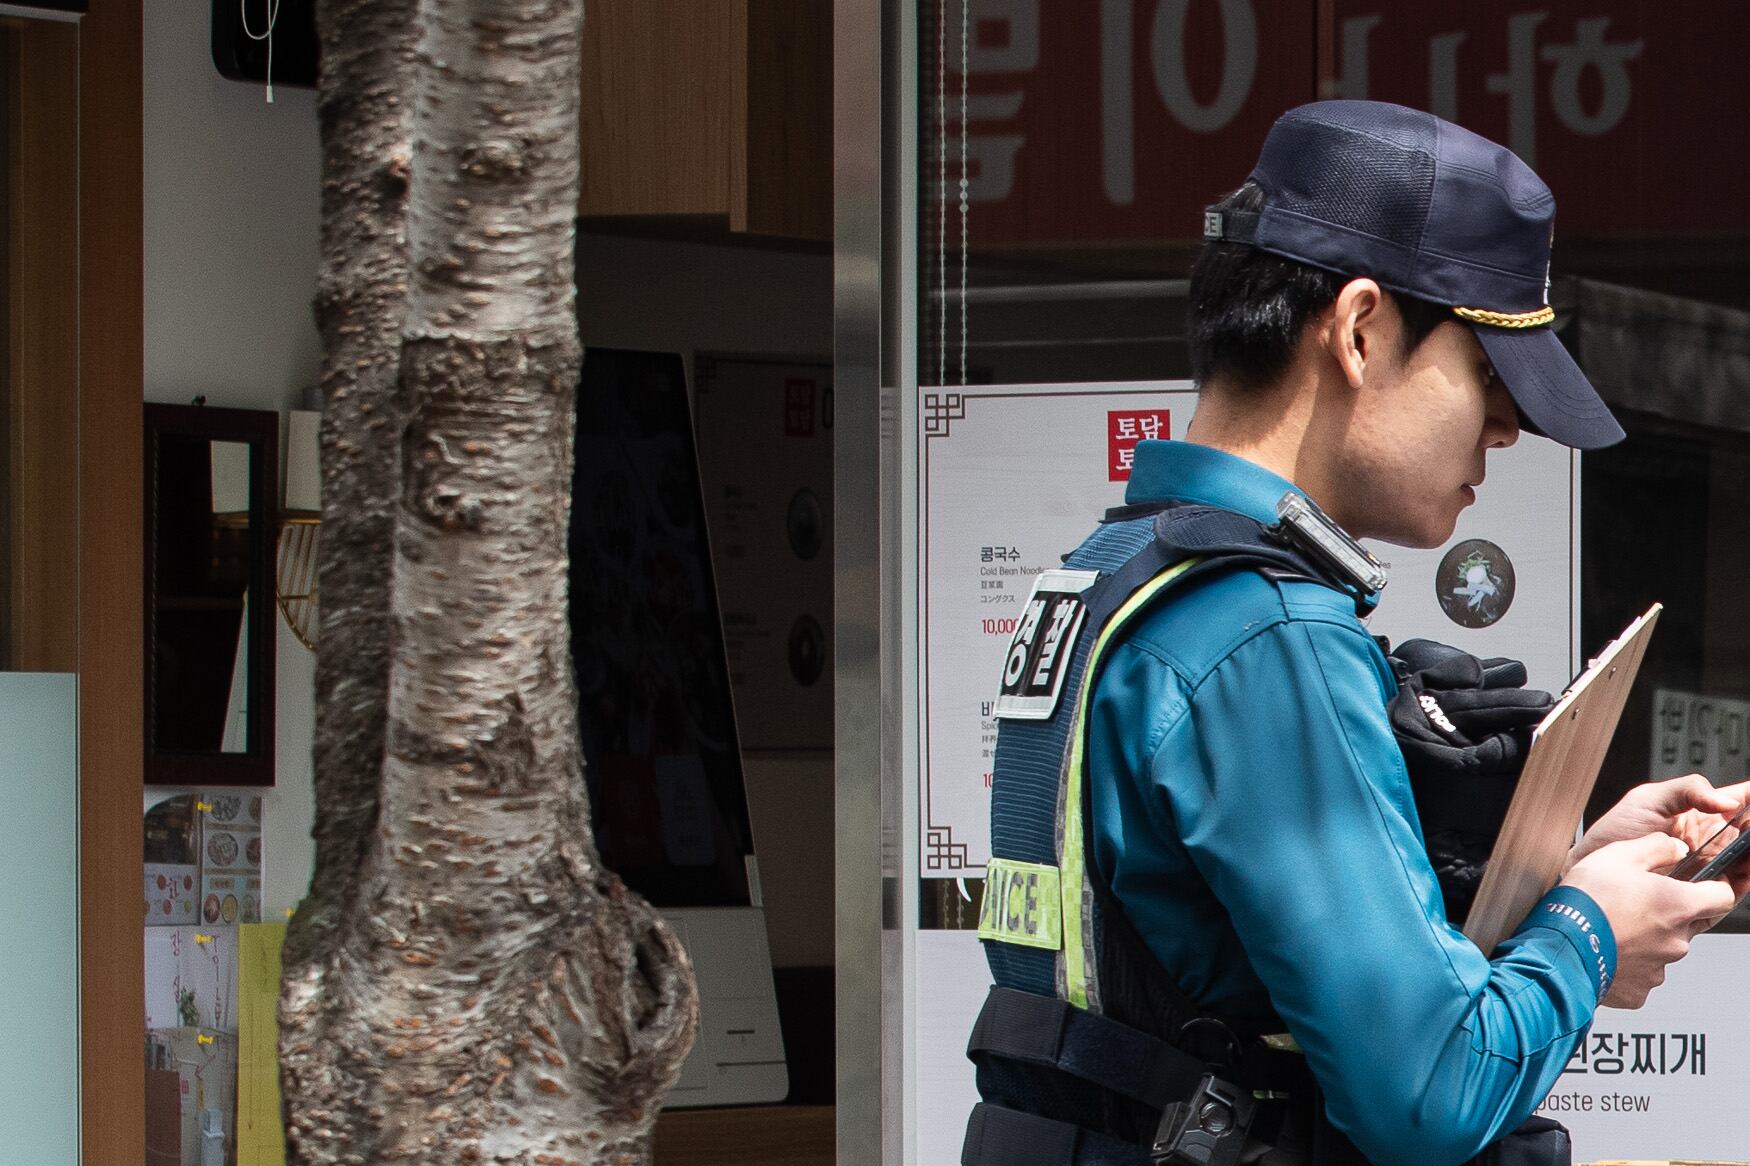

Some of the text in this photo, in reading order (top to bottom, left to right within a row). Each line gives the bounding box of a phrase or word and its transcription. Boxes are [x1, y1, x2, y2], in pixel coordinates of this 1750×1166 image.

[1116, 448, 1135, 471] 토
[980, 547, 1020, 563] 콩국수
[980, 567, 997, 576] Cold
[1000, 568, 1018, 576] Bean
[1003, 599, 1078, 688] 경찰
[1600, 1092, 1651, 1113] stew
